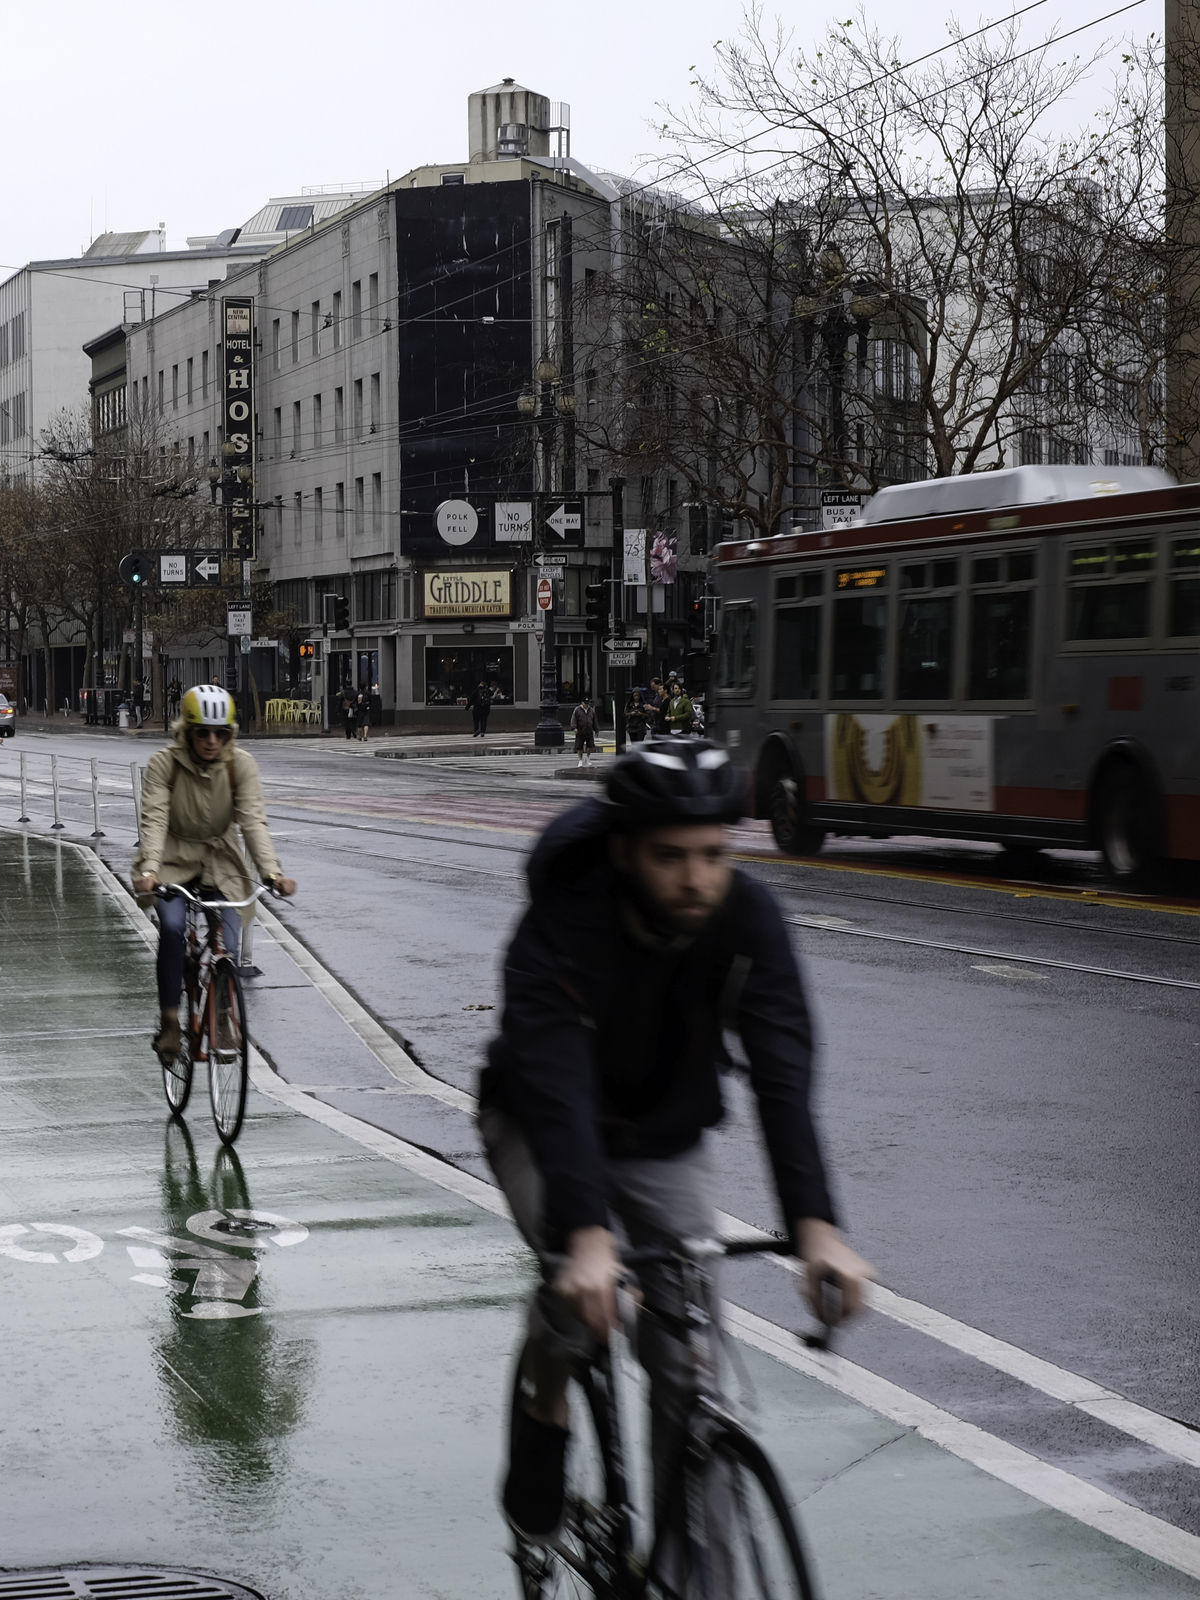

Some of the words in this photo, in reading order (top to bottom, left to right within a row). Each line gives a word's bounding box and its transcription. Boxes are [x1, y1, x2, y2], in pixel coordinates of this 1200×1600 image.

[226, 340, 251, 349] HOTEL
[233, 355, 244, 363] &
[507, 513, 520, 521] NO
[498, 523, 530, 532] TURNS
[430, 574, 503, 604] GRIDDLE
[429, 606, 461, 614] TRADITIONAL
[461, 605, 486, 613] AMERICAN
[486, 604, 505, 613] EATERY
